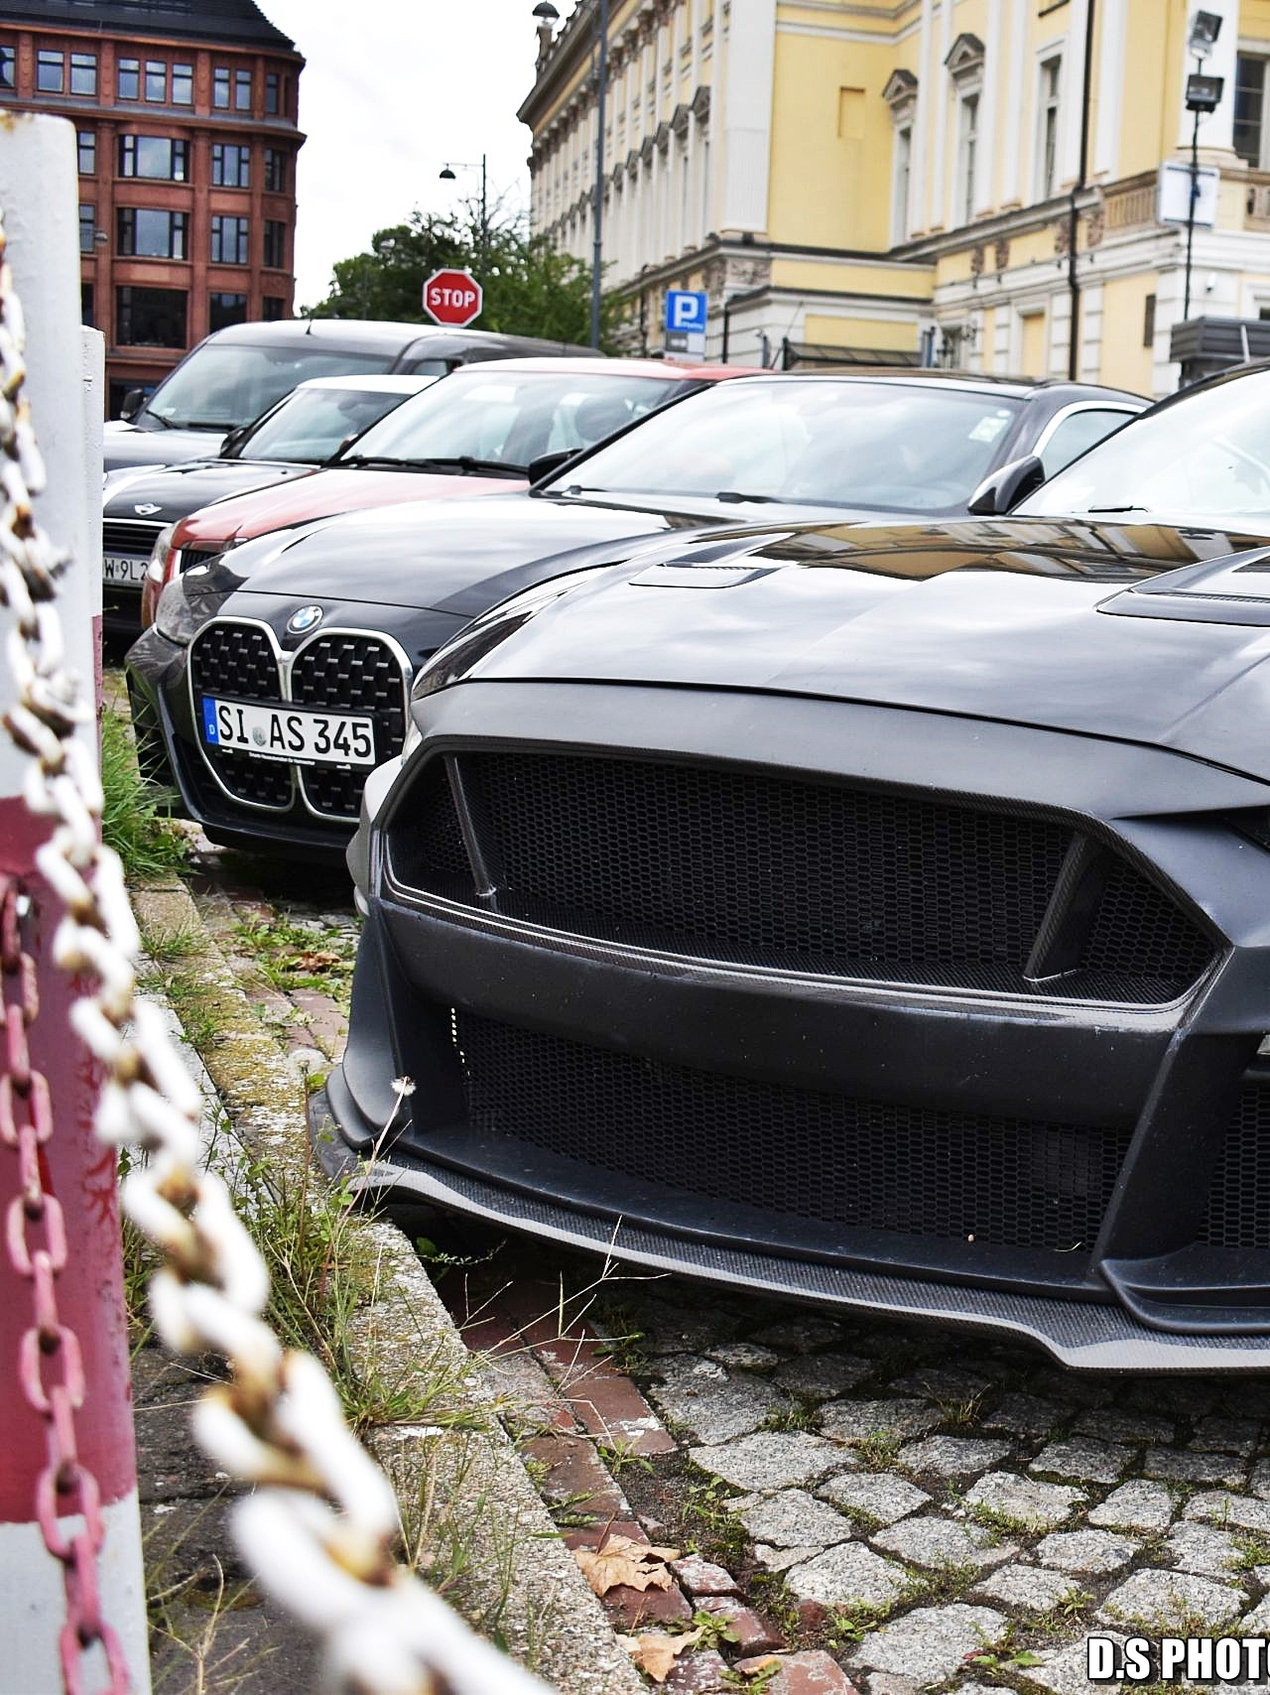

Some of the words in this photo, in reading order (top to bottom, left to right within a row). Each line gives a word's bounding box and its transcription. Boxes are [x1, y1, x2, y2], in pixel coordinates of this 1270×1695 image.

[430, 287, 476, 308] STOP
[674, 295, 699, 328] P
[218, 705, 249, 744] SI
[269, 713, 306, 752] AS
[312, 718, 372, 758] 345
